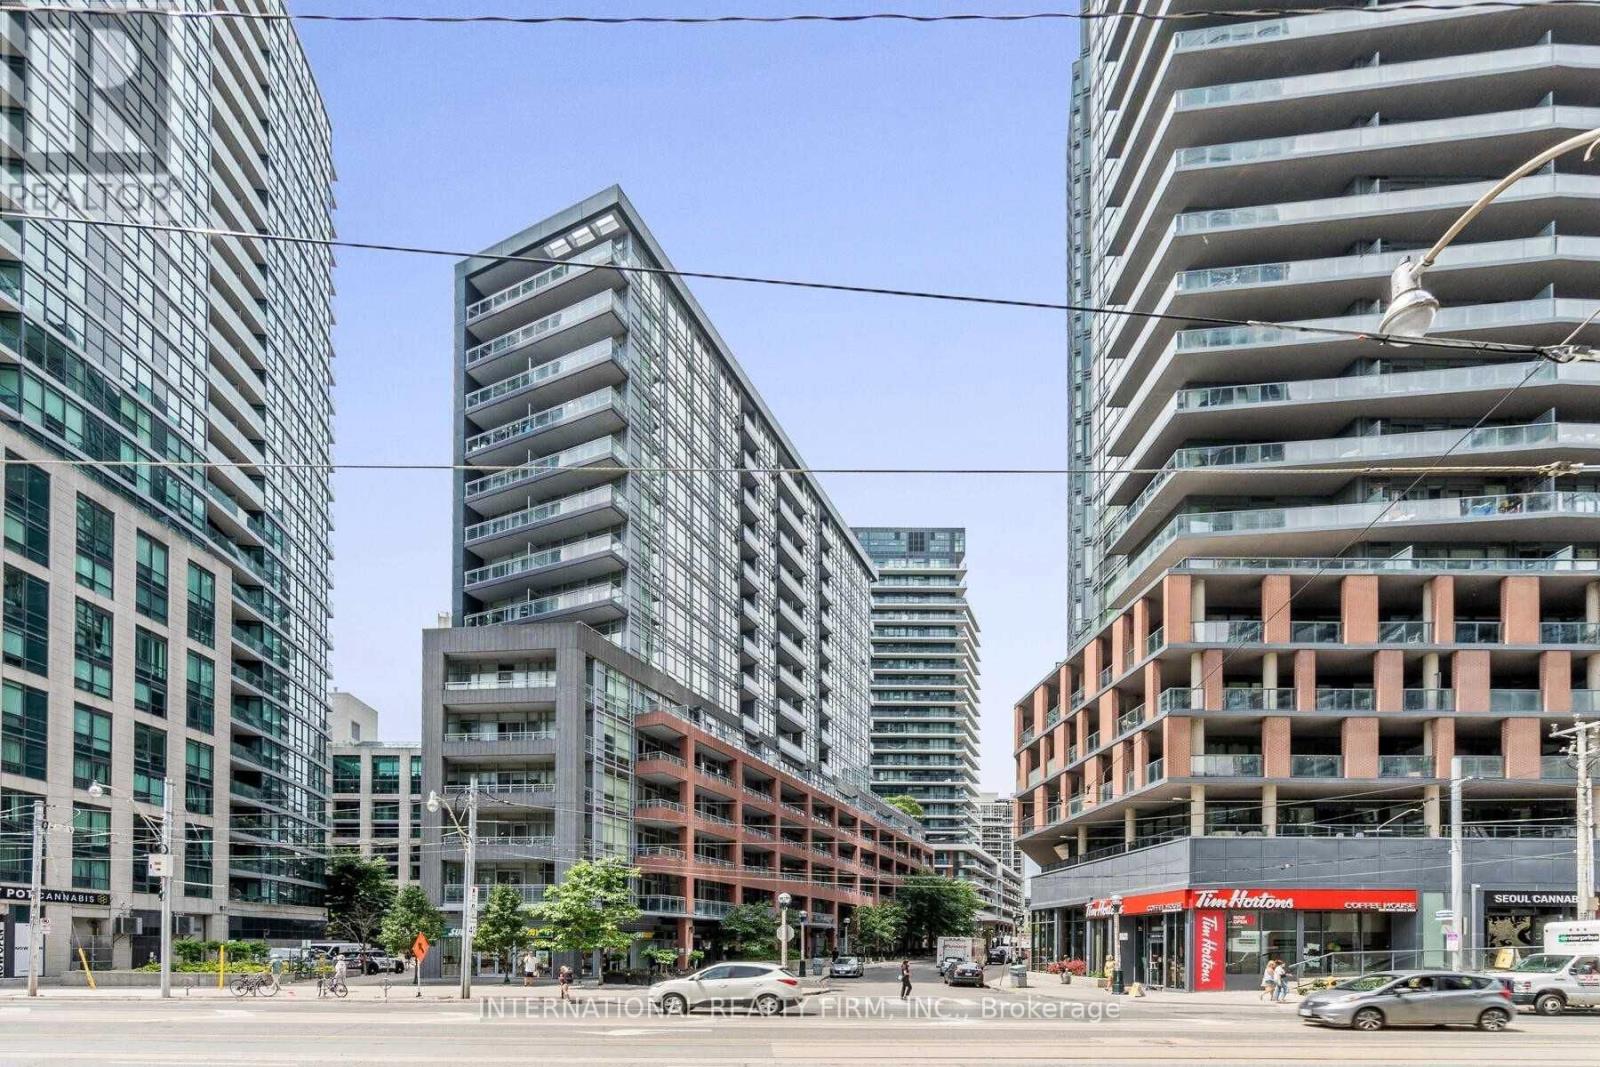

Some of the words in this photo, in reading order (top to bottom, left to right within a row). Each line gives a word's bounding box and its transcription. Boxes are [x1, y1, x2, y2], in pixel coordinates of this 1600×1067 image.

[1194, 889, 1227, 908] Tim
[1228, 889, 1294, 908] Hortons
[1495, 894, 1531, 903] SEOUL
[1533, 894, 1579, 903] CANNAB
[1201, 916, 1218, 937] Tim
[1201, 938, 1218, 983] Hortons
